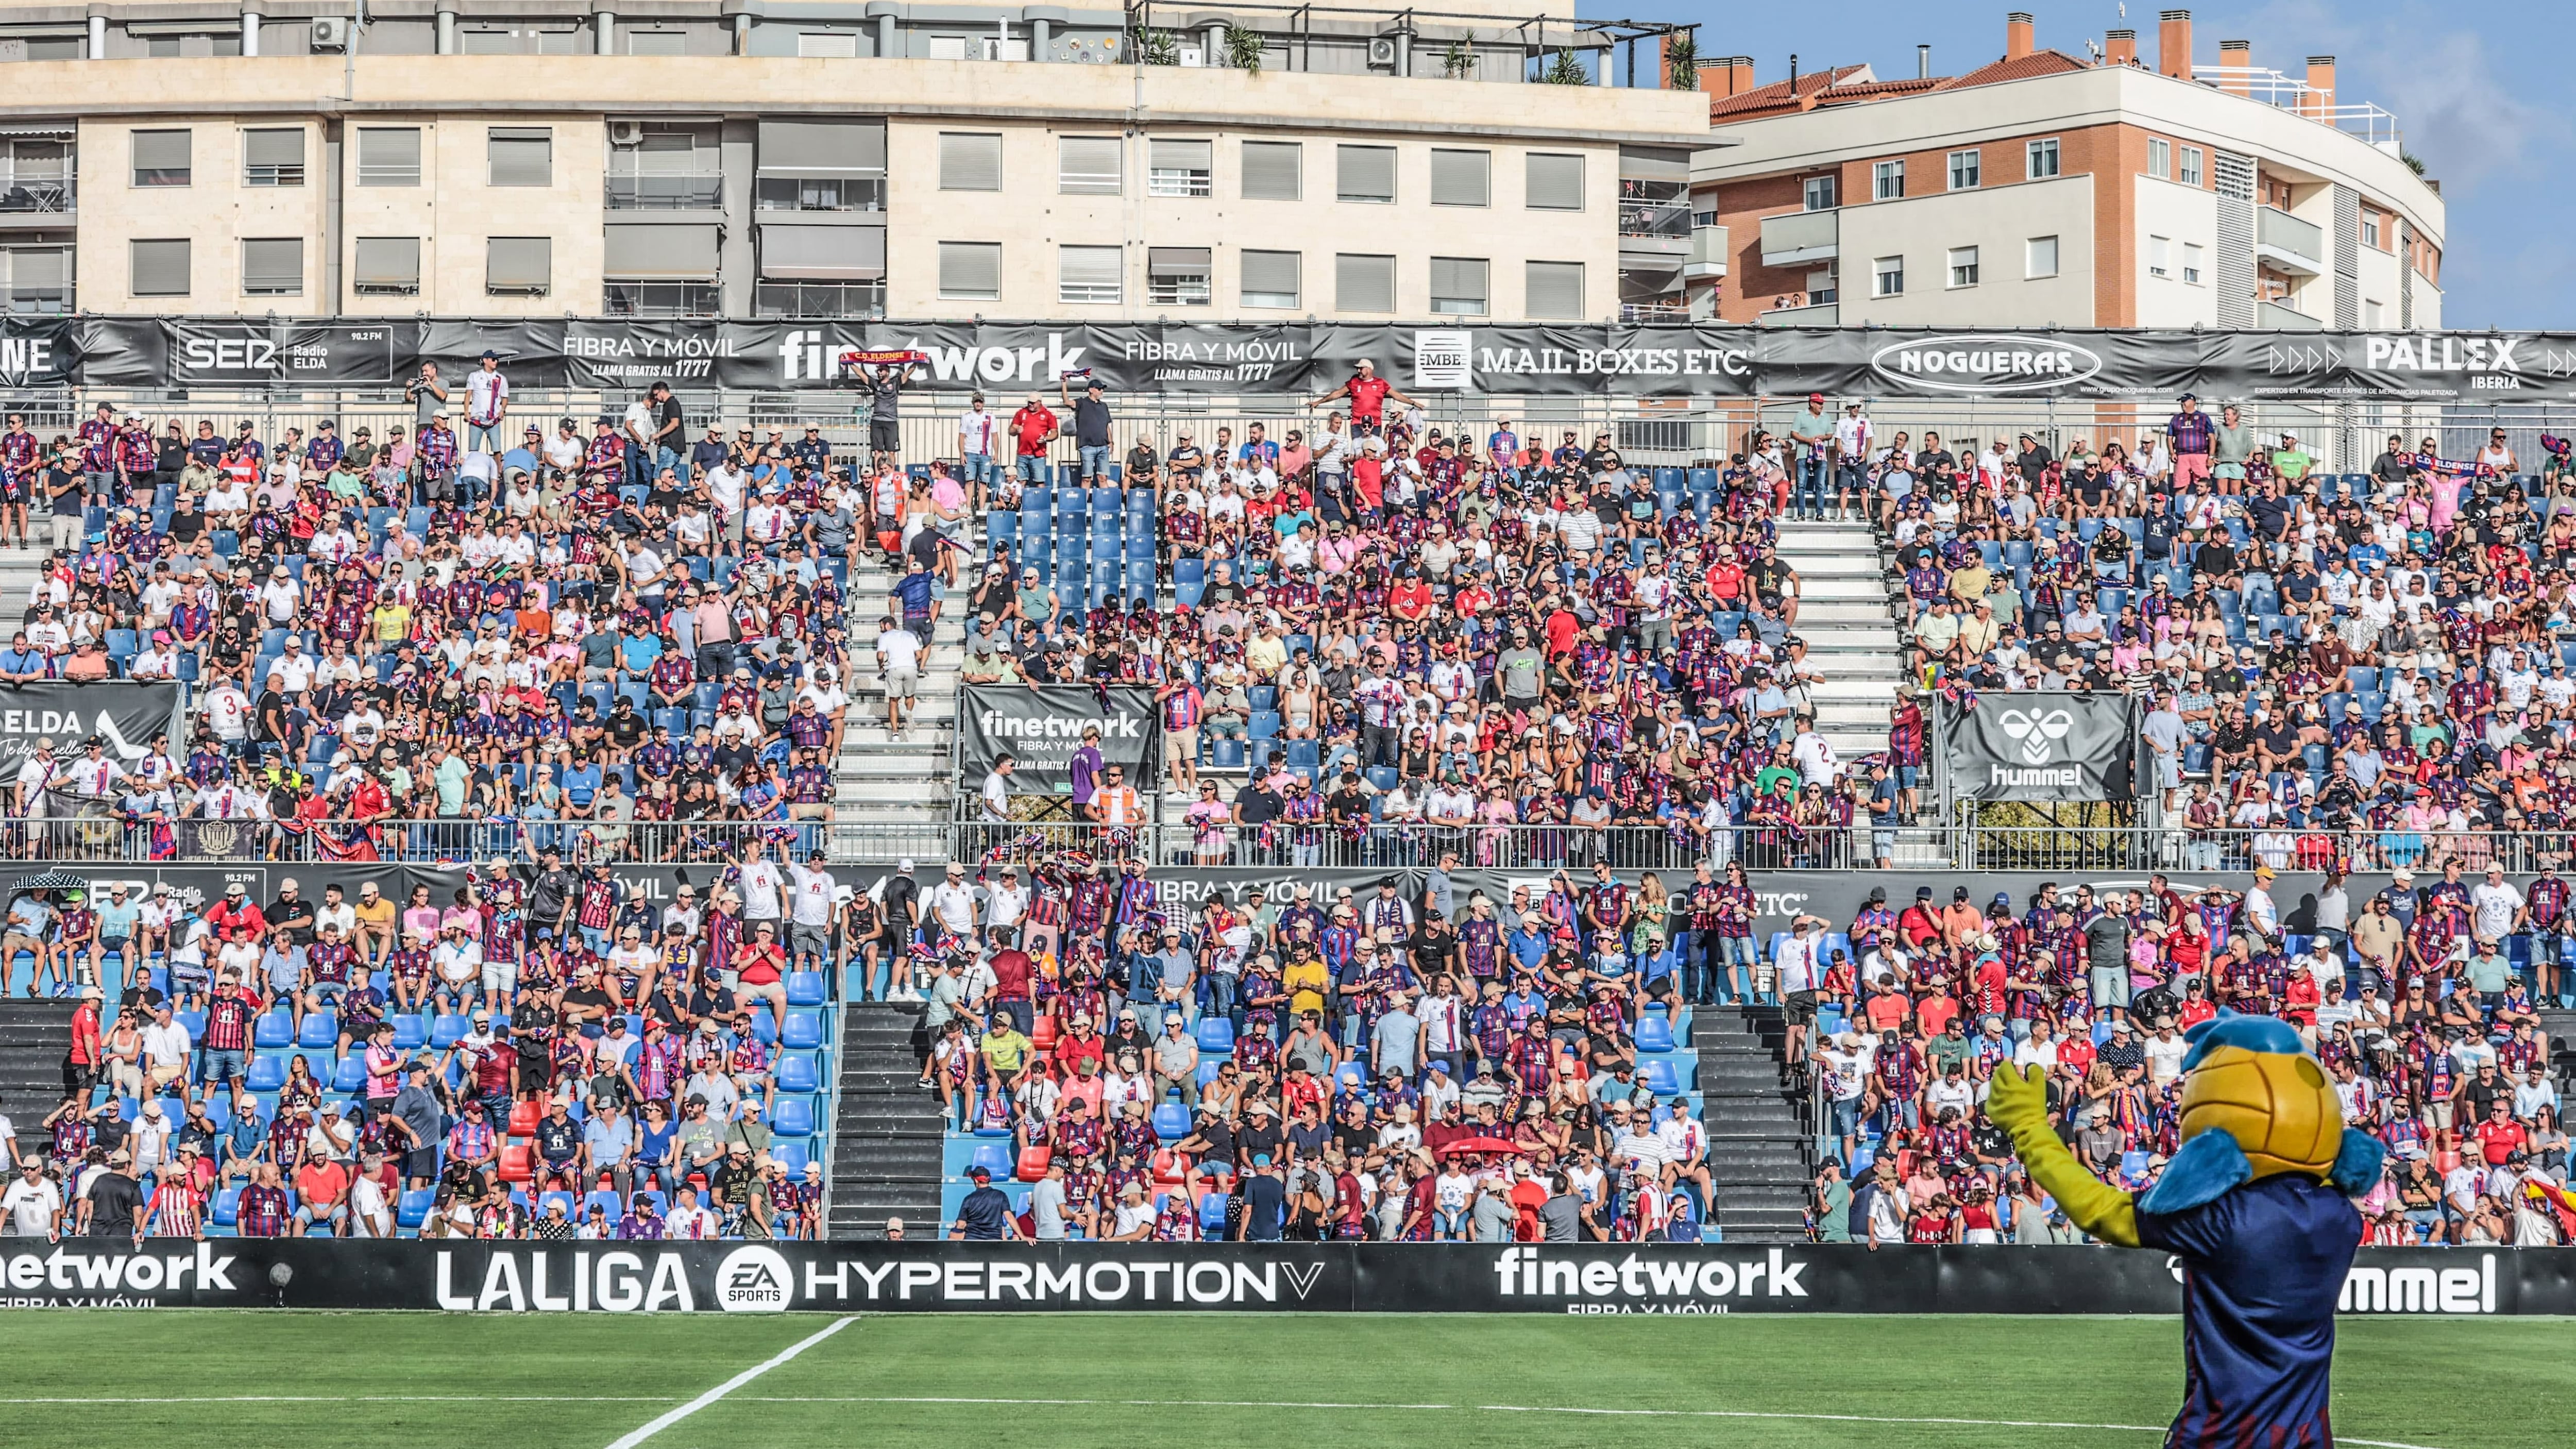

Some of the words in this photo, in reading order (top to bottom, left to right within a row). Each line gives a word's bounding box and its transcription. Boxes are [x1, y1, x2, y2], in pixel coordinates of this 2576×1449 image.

[294, 345, 328, 357] Radio
[563, 337, 635, 357] FIBRA
[642, 338, 660, 357] Y
[664, 333, 740, 357] MÓVIL
[1125, 342, 1197, 360] FIBRA
[1202, 342, 1220, 360] Y
[1227, 338, 1302, 360] MÓVIL
[2366, 338, 2520, 371] PALLEX
[294, 358, 327, 369] ELDA
[592, 364, 623, 376] LLAMA
[625, 365, 659, 376] GRATIS
[660, 365, 673, 376] AL
[675, 360, 711, 376] 1777
[1426, 353, 1461, 365] MBE
[1481, 347, 1571, 374] MAIL
[1577, 348, 1678, 375] BOXES
[1900, 350, 2073, 376] NOGUERAS
[1155, 368, 1185, 380] LLAMA
[1188, 368, 1222, 380] GRATIS
[1223, 369, 1234, 380] AL
[1237, 364, 1274, 380] 1777
[2080, 385, 2174, 395] www.grupo-nogueras.com
[2472, 376, 2520, 390] IBERIA
[2435, 460, 2475, 471] ELDENSE
[1514, 658, 1535, 669] AIR
[223, 695, 237, 715] 3
[5, 710, 82, 734] ELDA
[1018, 741, 1052, 751] FIBRA
[1055, 741, 1064, 750] Y
[1066, 738, 1103, 751] MÓL
[1818, 743, 1829, 763] 2
[1013, 761, 1036, 770] LAMA
[1037, 761, 1064, 770] GRATIS
[1064, 761, 1071, 770] A
[1992, 764, 2081, 786] hummel
[167, 886, 201, 898] Radio
[1151, 881, 1218, 902] IBRA
[1226, 881, 1244, 902] Y
[0, 1242, 236, 1290] etwork
[729, 1262, 779, 1288] EA
[1495, 1246, 1809, 1296] finetwork
[436, 1251, 694, 1311] LALIGA
[805, 1261, 1277, 1302] HYPERMOTION
[2338, 1253, 2496, 1312] mmel
[728, 1290, 781, 1302] SPORTS
